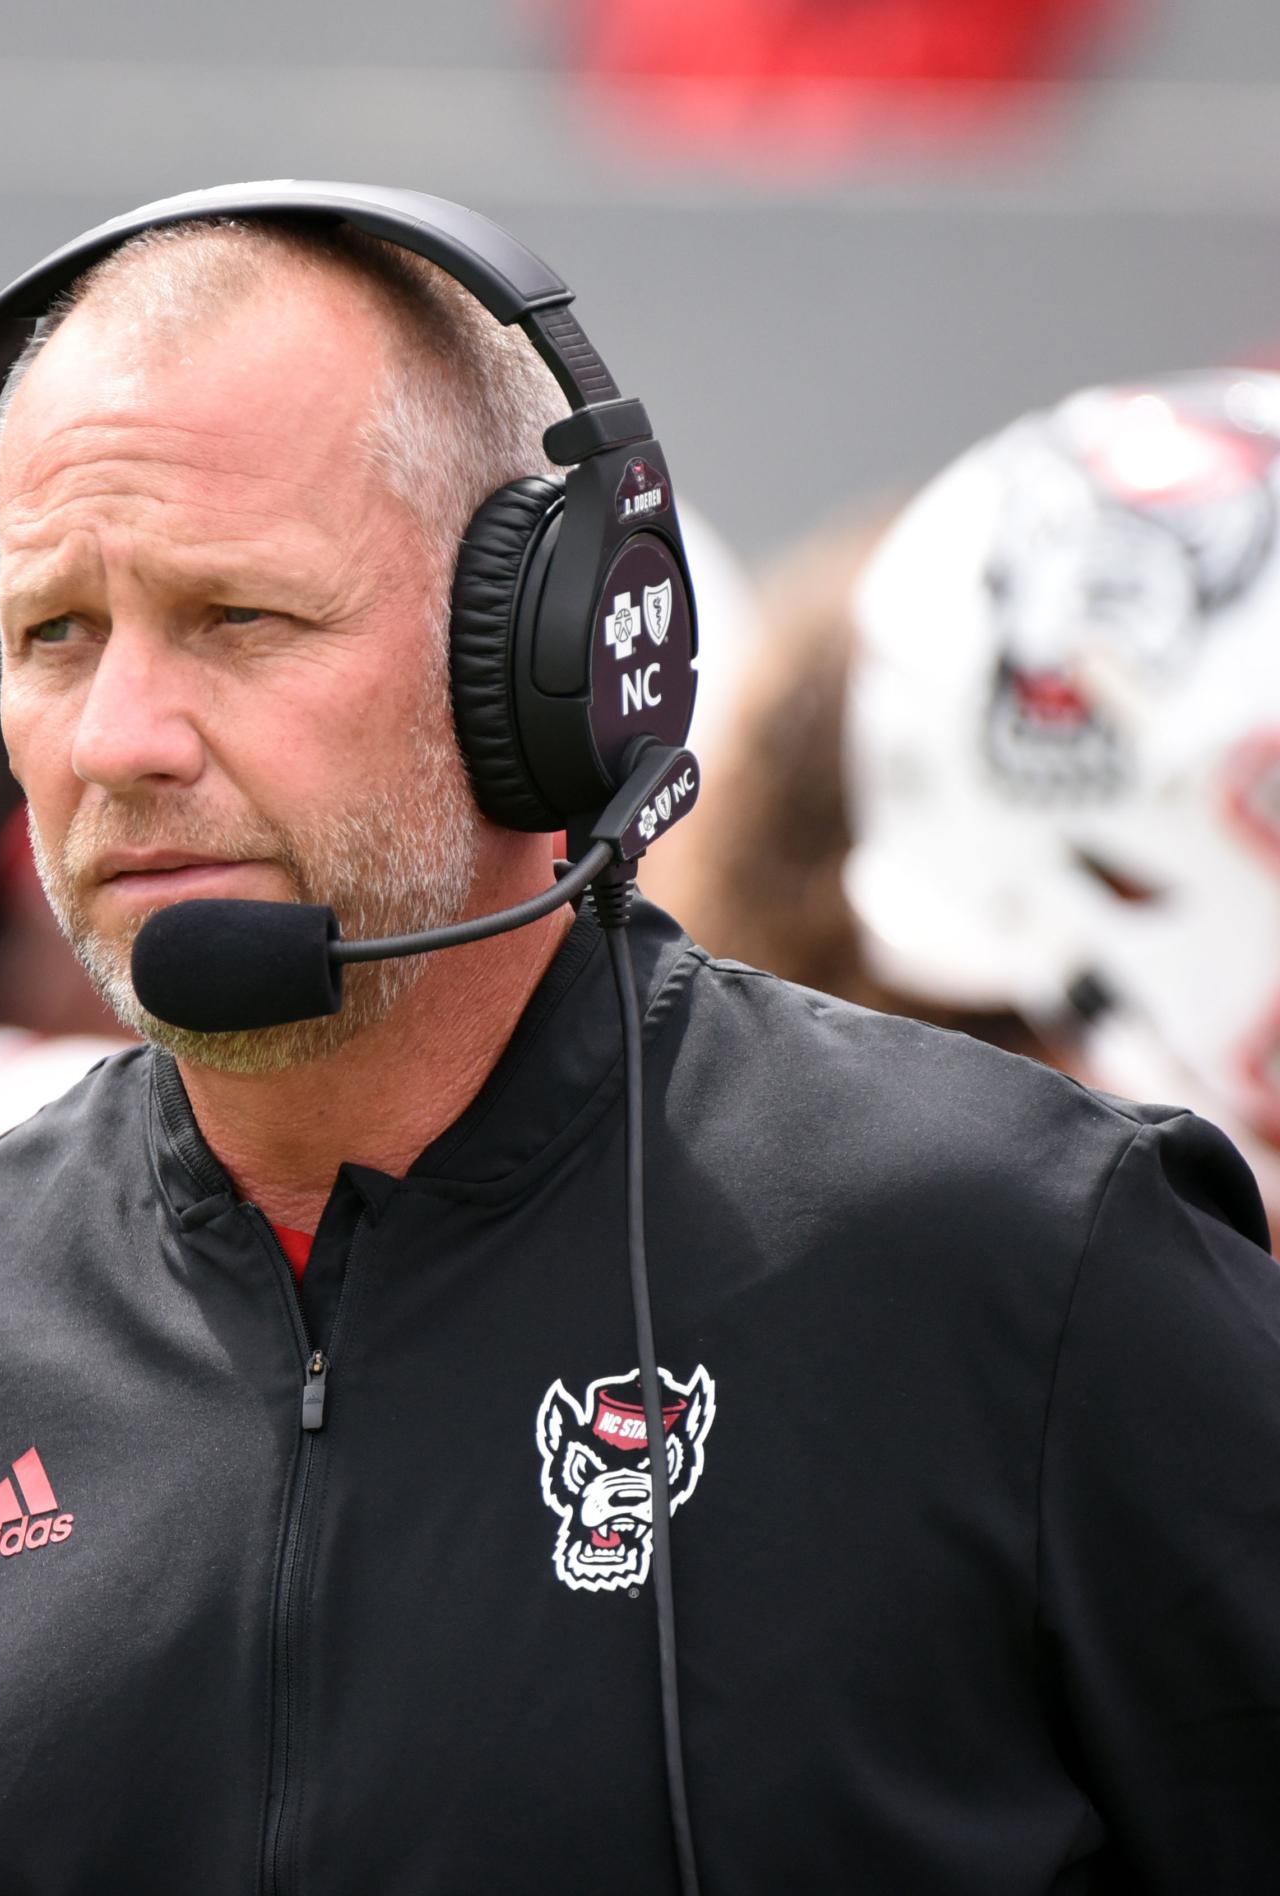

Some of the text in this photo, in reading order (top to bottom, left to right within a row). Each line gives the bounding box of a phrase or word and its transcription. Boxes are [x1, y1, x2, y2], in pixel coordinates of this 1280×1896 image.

[634, 488, 661, 512] DOEREN
[622, 662, 662, 716] NC
[672, 767, 695, 803] NC
[598, 1412, 622, 1434] NC
